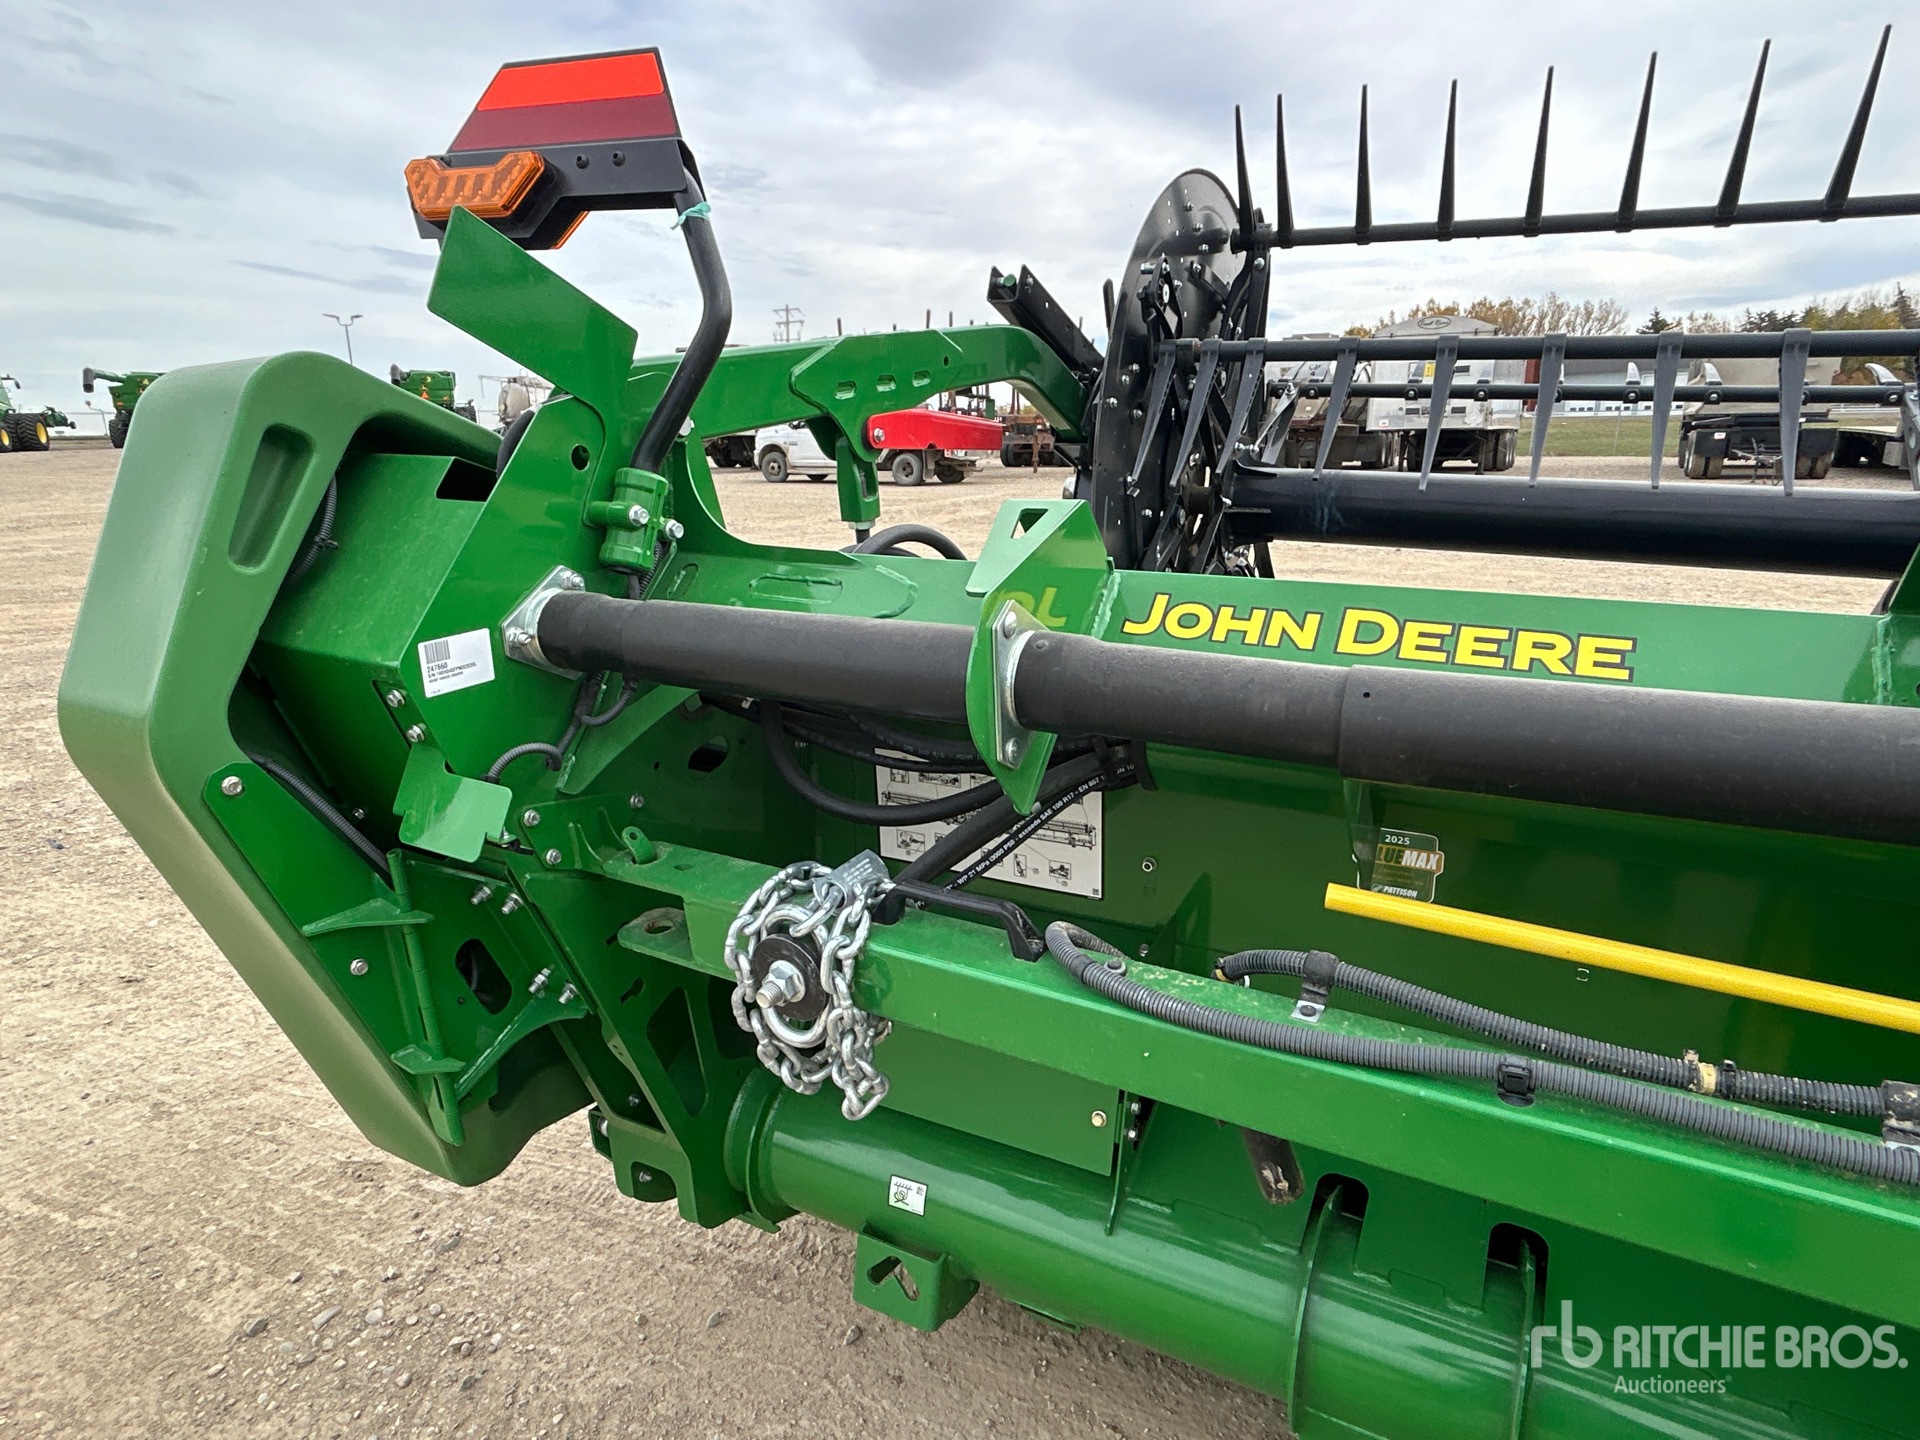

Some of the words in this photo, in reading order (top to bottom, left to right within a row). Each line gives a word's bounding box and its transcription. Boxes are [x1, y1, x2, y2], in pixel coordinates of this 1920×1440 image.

[1122, 592, 1325, 652] JOHN
[1334, 606, 1638, 682] DEERE
[956, 874, 968, 885] WP
[975, 859, 990, 872] MPa
[1018, 818, 1042, 839] exceeds
[1040, 808, 1054, 821] SAE
[1052, 800, 1063, 811] 100
[1062, 791, 1075, 804] R17
[1078, 783, 1089, 793] EN
[1384, 834, 1411, 845] 2025
[1377, 845, 1440, 870] LUEMAX
[1383, 885, 1419, 898] PATTISON
